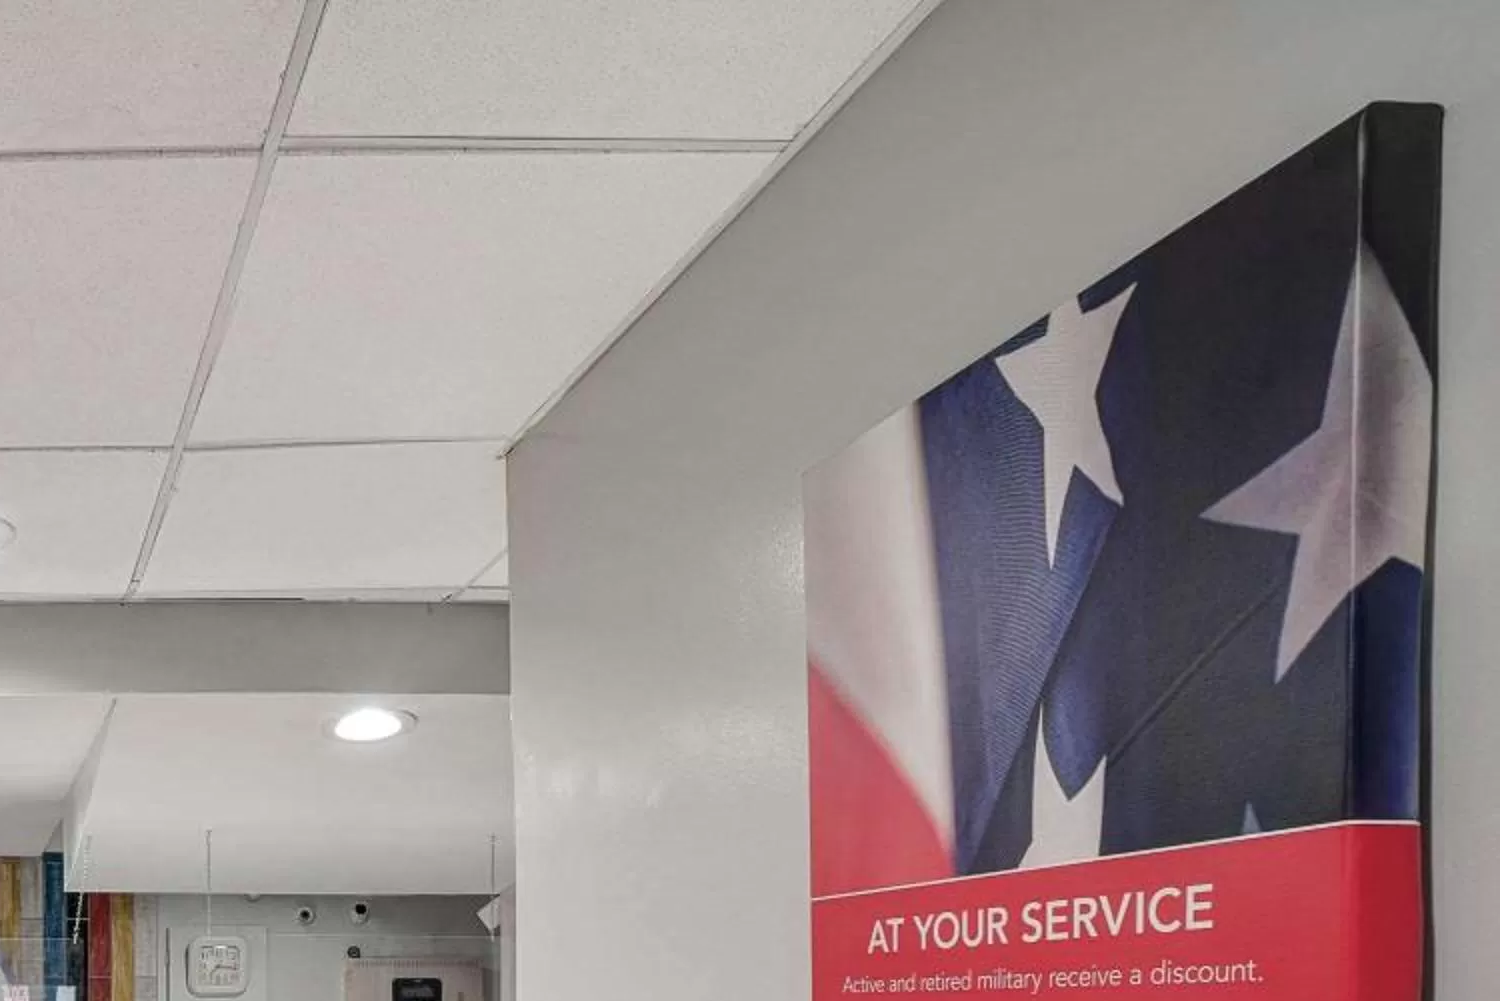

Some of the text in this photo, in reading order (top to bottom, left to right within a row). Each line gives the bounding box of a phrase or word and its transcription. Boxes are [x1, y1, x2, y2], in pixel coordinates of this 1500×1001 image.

[867, 882, 1214, 955] AT YOUR SERVICE
[842, 959, 1265, 995] Active and retired military receive a discount.
